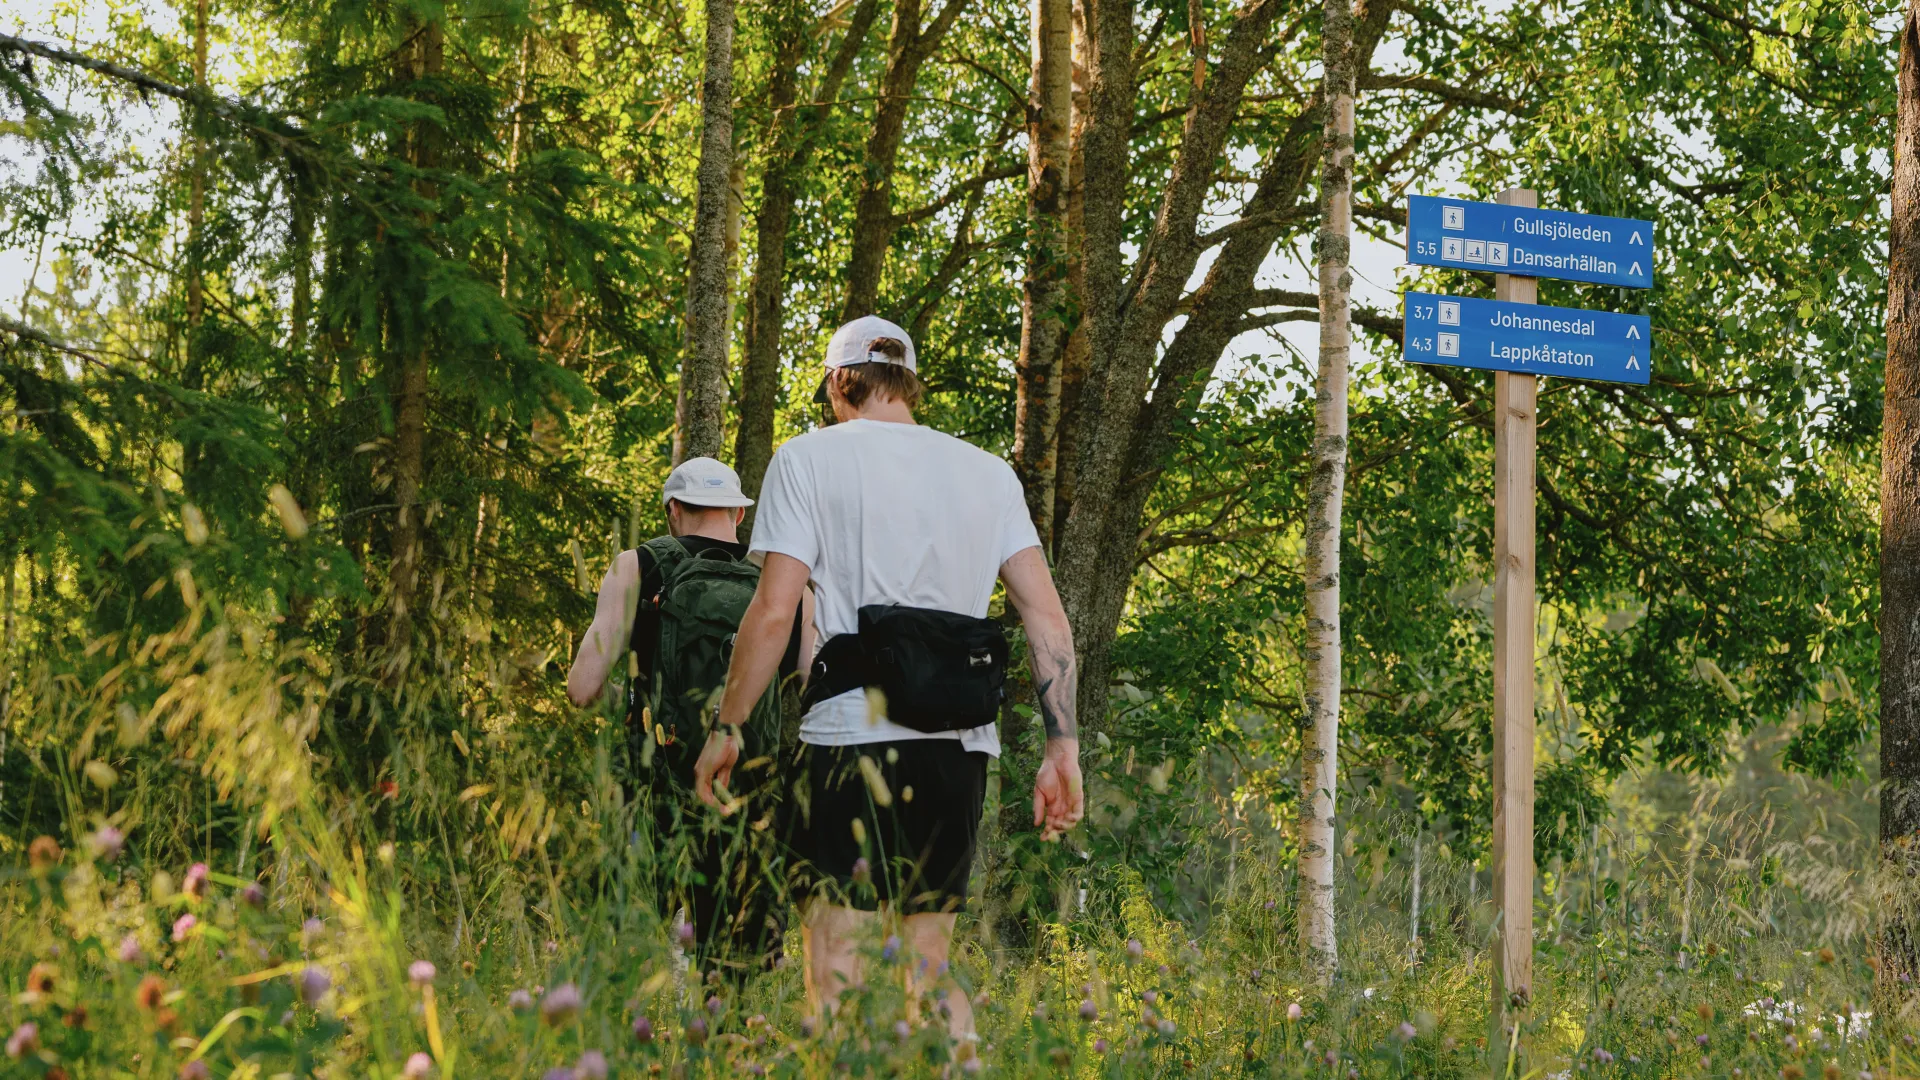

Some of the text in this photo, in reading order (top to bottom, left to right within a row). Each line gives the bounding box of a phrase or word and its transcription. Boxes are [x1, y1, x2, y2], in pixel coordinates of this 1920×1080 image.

[1514, 217, 1611, 243] Gullsjöleden
[1416, 241, 1437, 256] 5,5
[1513, 247, 1617, 275] Dansarhällan
[1414, 305, 1595, 336] 3,7 Johannesdal
[1412, 337, 1594, 367] 4,3 Lappkåtaton
